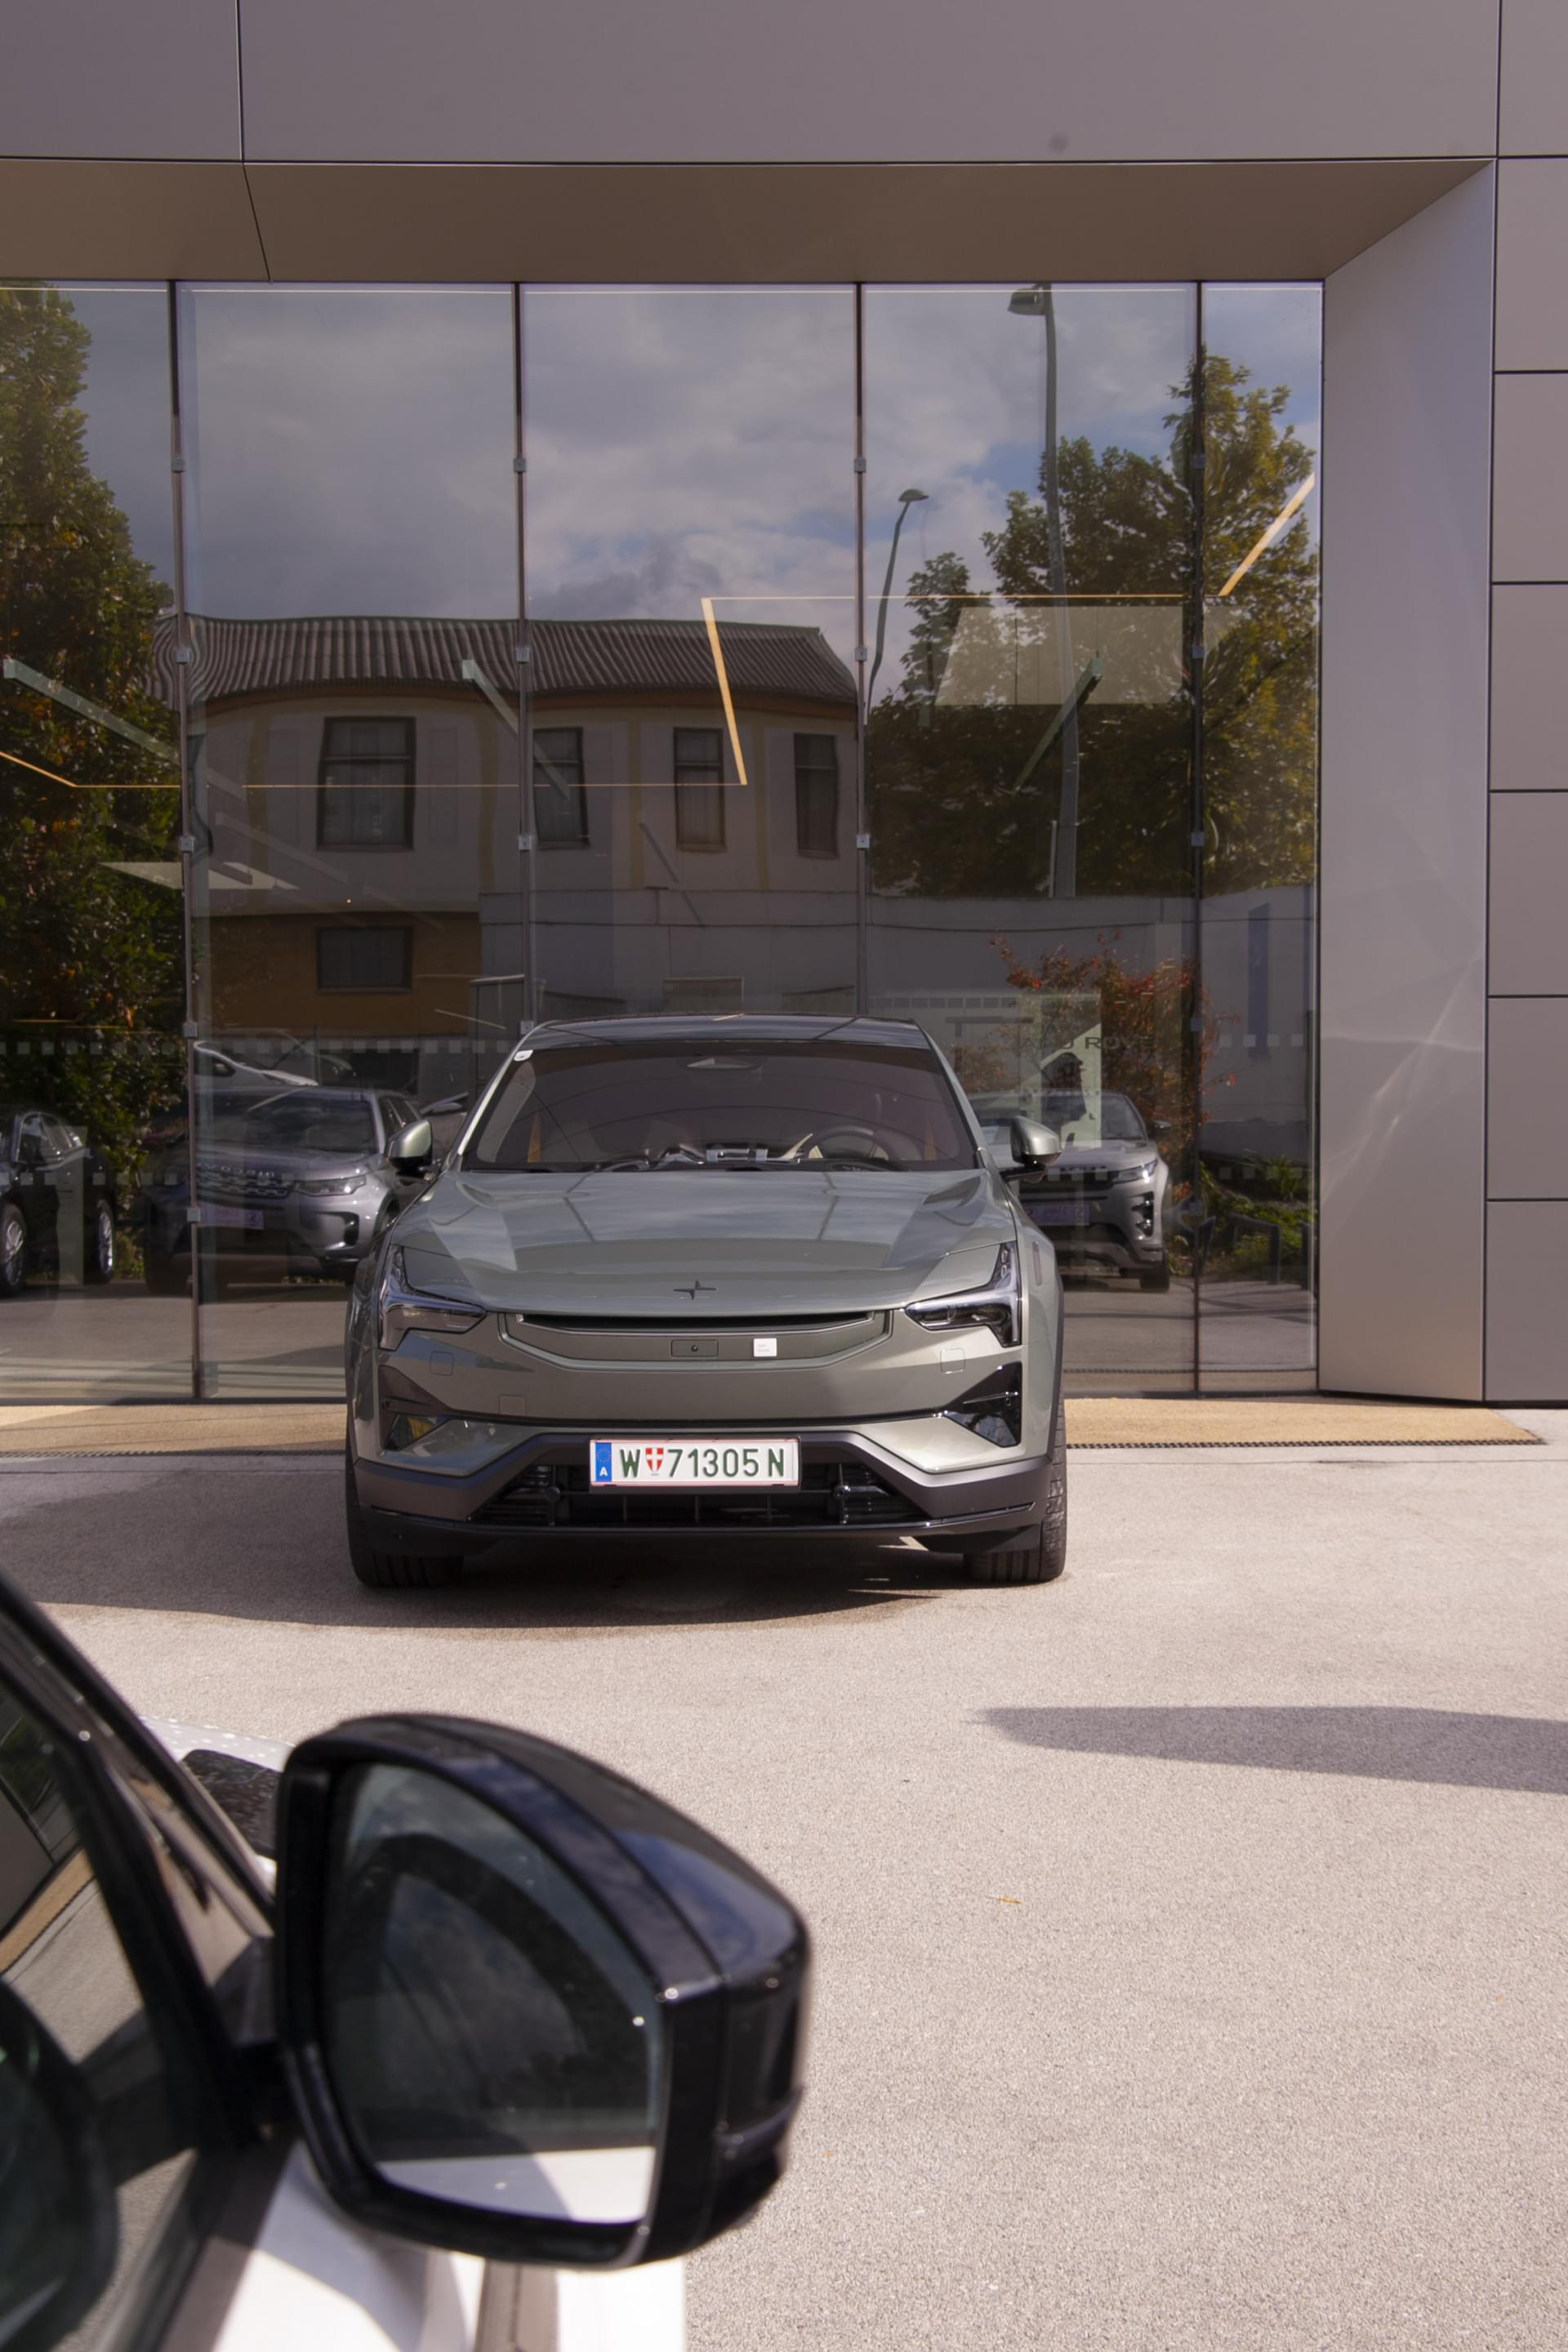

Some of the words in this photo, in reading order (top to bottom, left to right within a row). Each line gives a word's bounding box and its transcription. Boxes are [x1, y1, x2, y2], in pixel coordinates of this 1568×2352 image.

[599, 1467, 608, 1477] A
[620, 1449, 641, 1477] W
[667, 1448, 760, 1477] 71305
[768, 1448, 784, 1477] N
